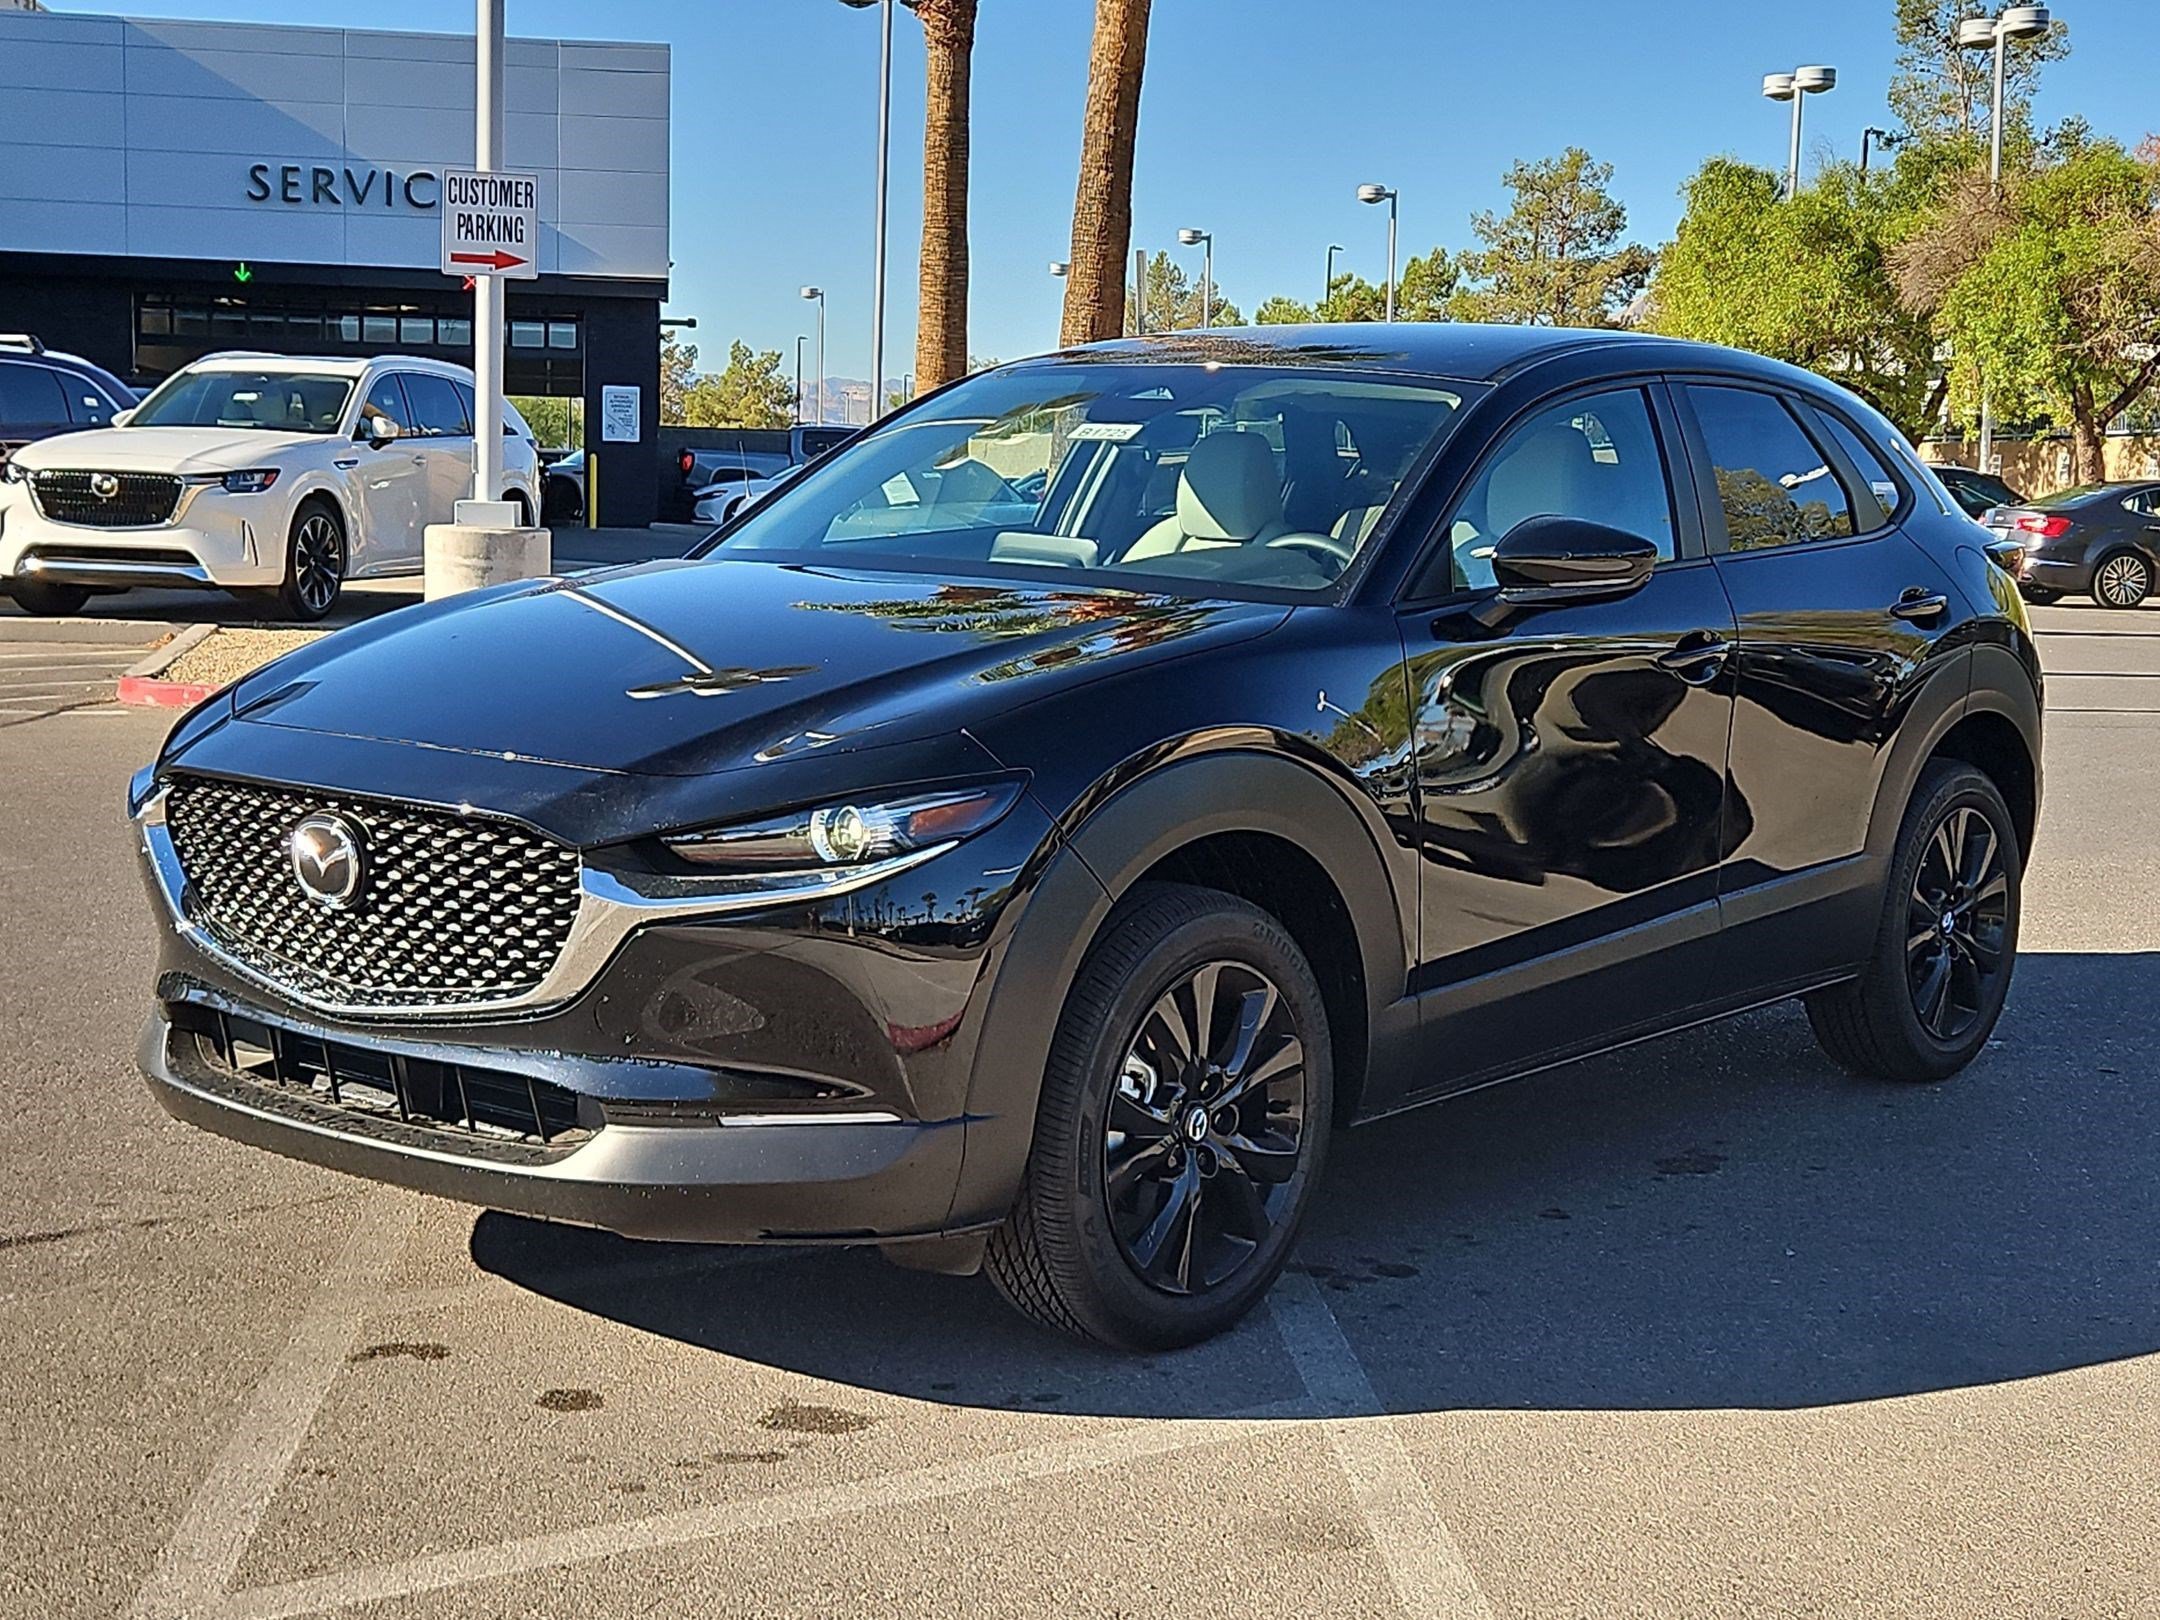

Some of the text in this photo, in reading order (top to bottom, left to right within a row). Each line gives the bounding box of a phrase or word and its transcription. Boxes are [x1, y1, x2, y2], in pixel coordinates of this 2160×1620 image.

[247, 164, 436, 209] SERVIC
[448, 175, 534, 209] CUSTOMER
[457, 212, 525, 244] PARKING
